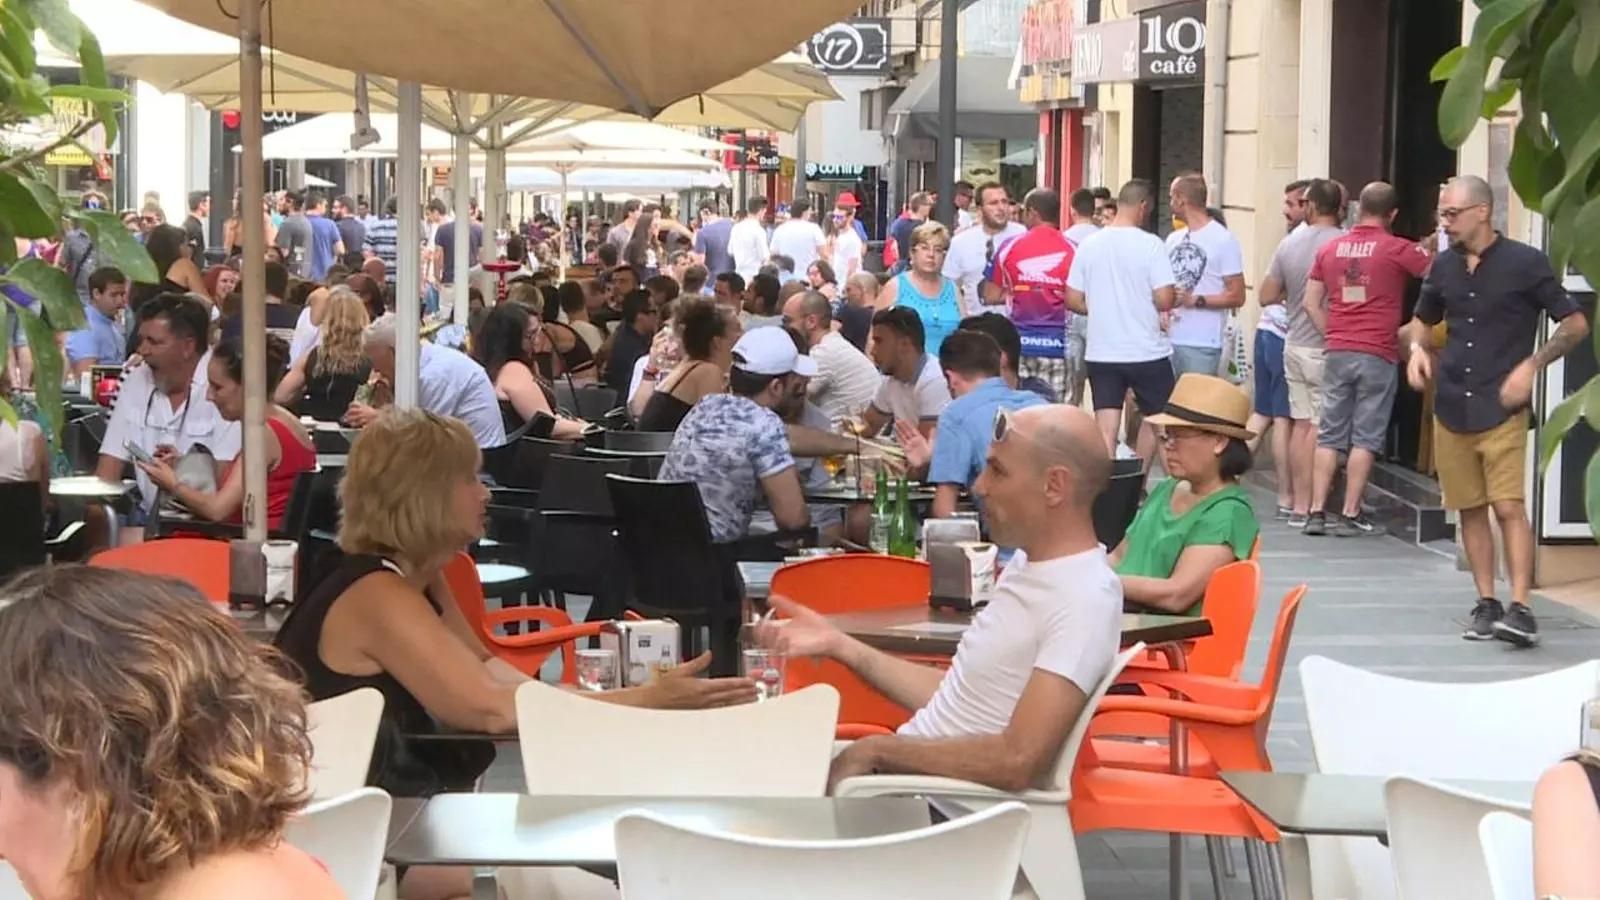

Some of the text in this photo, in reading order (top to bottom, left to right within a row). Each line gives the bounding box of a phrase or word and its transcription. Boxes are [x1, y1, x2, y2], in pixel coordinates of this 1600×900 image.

[1141, 15, 1206, 54] 10
[824, 38, 852, 61] 17
[1150, 55, 1197, 74] café
[1017, 272, 1064, 285] HONDA
[1020, 336, 1063, 348] ONDA
